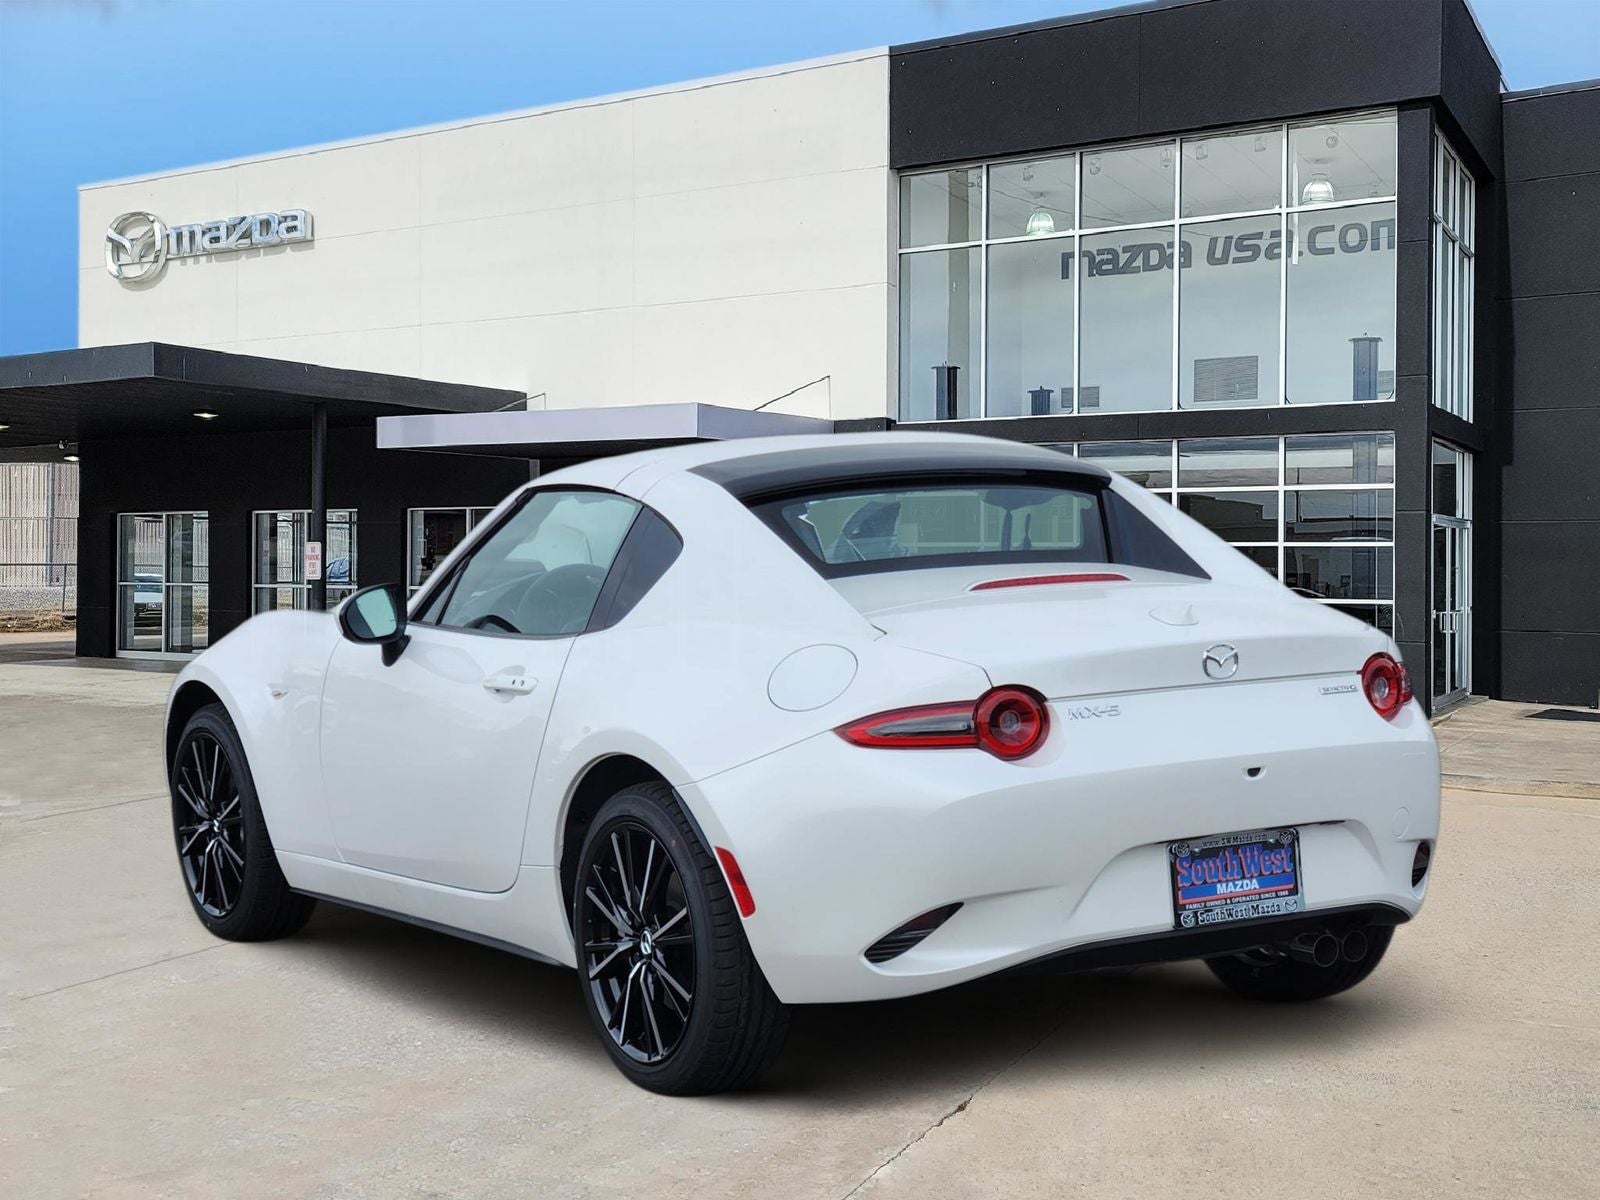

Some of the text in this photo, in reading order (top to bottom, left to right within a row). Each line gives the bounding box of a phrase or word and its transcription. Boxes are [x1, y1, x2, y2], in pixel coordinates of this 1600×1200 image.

[167, 209, 314, 257] mazda
[1061, 241, 1192, 280] mazda
[1066, 704, 1121, 721] MX-5
[1176, 845, 1294, 887] SouthWest
[1216, 878, 1260, 895] MAZDA
[1205, 899, 1226, 907] OWNED
[1231, 894, 1260, 903] OPERATED
[1250, 902, 1281, 917] Mazda
